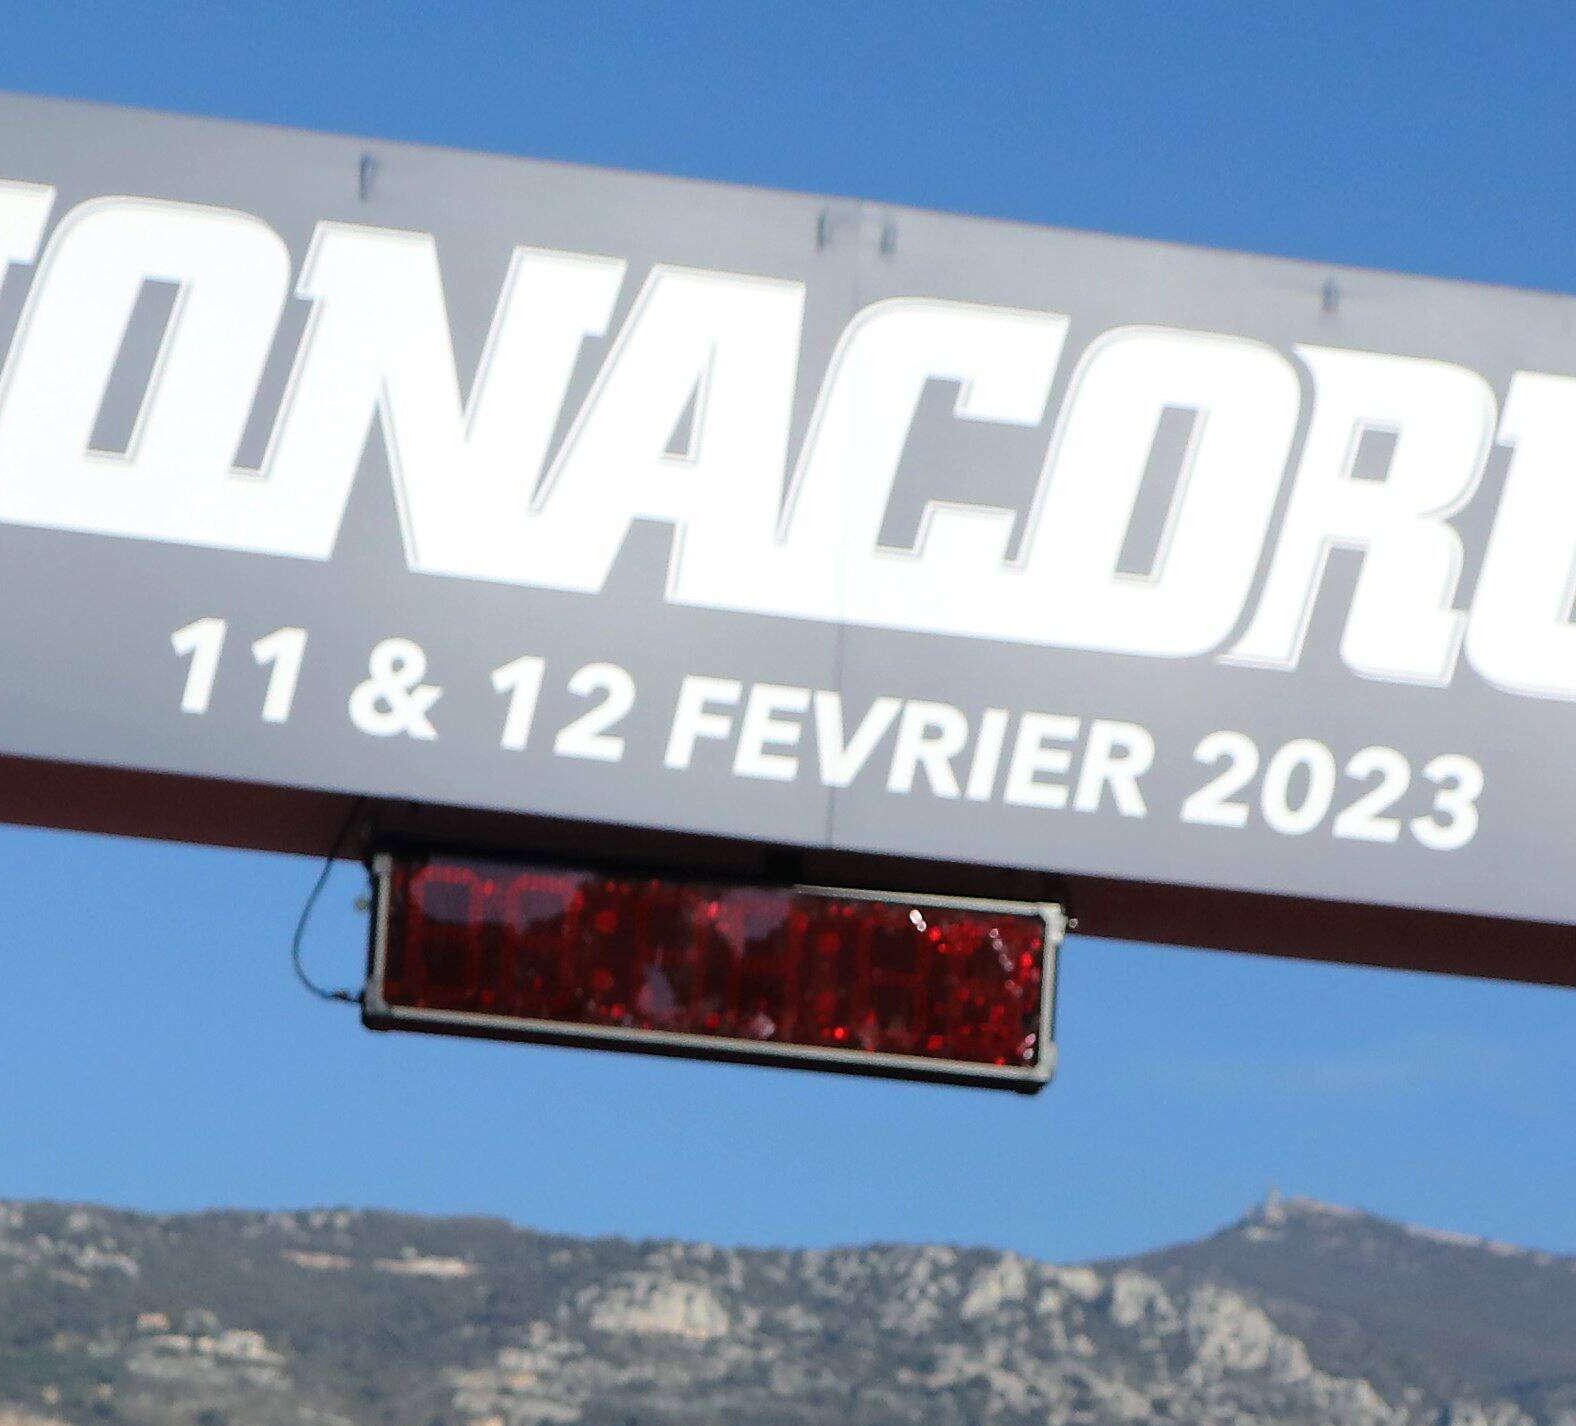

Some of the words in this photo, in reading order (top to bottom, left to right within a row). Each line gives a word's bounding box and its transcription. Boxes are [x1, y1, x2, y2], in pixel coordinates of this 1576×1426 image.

[169, 616, 309, 724] 11
[347, 638, 440, 743] &
[491, 655, 637, 761] 12
[664, 676, 1156, 820] FEVRIER
[1180, 727, 1487, 850] 2023
